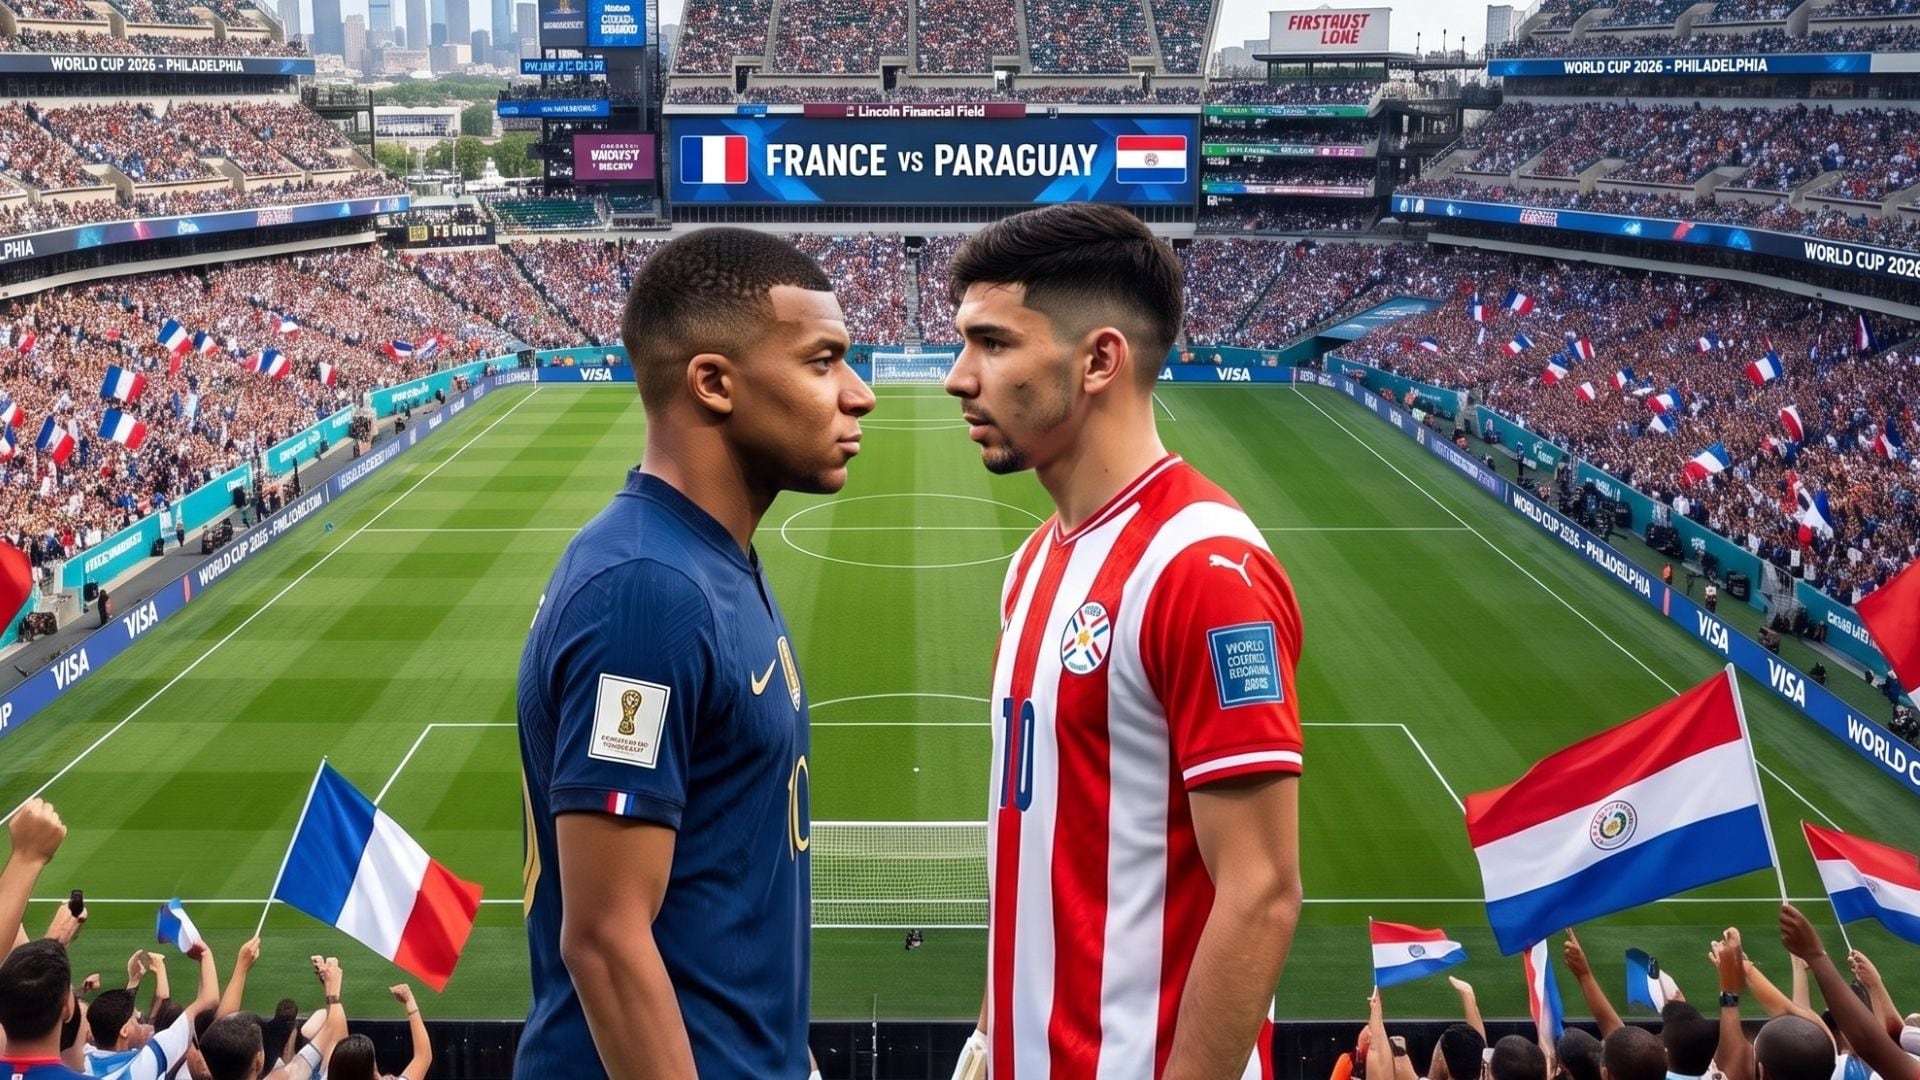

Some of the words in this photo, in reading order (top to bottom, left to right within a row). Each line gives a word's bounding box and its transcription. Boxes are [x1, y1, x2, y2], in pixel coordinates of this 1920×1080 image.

[50, 57, 97, 71] WORLD
[100, 58, 124, 71] CUP
[127, 58, 156, 71] 2026
[166, 59, 244, 72] PHILADELPHIA
[1564, 61, 1604, 74] WORLD
[1607, 61, 1631, 74] CUP
[1633, 60, 1663, 73] 2026
[1674, 58, 1768, 73] PHILADELPHIA
[858, 105, 900, 117] Lincoln
[902, 105, 955, 117] Financial
[957, 105, 985, 117] Field
[766, 143, 888, 177] FRANCE
[934, 143, 1099, 177] PARAGUAY
[1804, 241, 1853, 266] WORLD
[1856, 251, 1885, 271] CUP
[579, 368, 613, 381] VISA
[1216, 367, 1251, 381] VISA
[1513, 491, 1541, 523] WORLD
[1542, 511, 1559, 534] CUP
[198, 554, 231, 587] WORLD
[231, 541, 249, 564] CUP
[123, 600, 159, 640] VISA
[1697, 610, 1729, 655] VISA
[50, 648, 90, 690] VISA
[1768, 658, 1805, 708] VISA
[999, 695, 1036, 812] 10
[1847, 714, 1906, 774] WORLD
